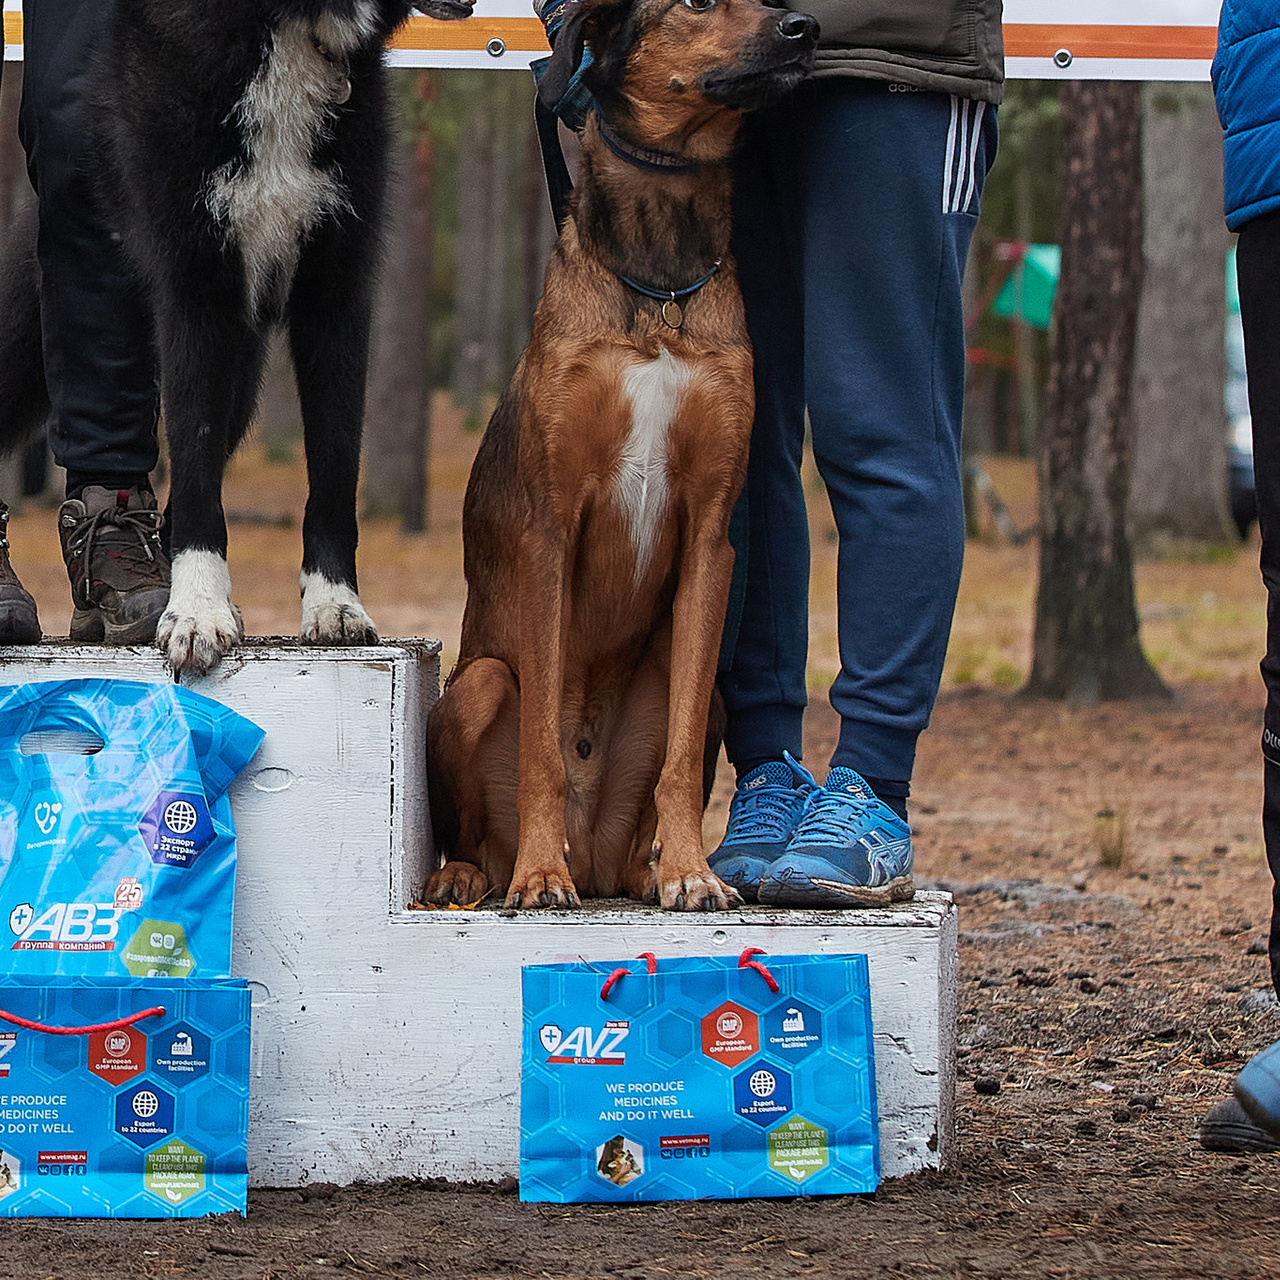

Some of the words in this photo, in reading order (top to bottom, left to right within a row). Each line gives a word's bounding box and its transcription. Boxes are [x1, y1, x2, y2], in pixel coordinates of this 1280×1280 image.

[161, 836, 195, 847] Экспорт
[160, 843, 171, 852] 22
[166, 852, 187, 861] мира
[117, 883, 142, 902] 25
[19, 903, 122, 942] АВЗ
[20, 941, 55, 951] группа
[58, 941, 106, 951] компаний
[552, 1026, 630, 1059] AVZ
[715, 1039, 746, 1047] European
[770, 1036, 785, 1044] Own
[785, 1034, 819, 1043] production
[725, 1044, 753, 1052] standard
[781, 1041, 808, 1049] facilities
[172, 1059, 207, 1067] production
[573, 1057, 597, 1065] group
[605, 1083, 626, 1094] WE
[628, 1080, 685, 1093] PRODUCE
[11, 1095, 68, 1106] PRODUCE
[613, 1095, 679, 1108] MEDICINES
[753, 1099, 775, 1108] Export
[749, 1106, 758, 1114] 22
[757, 1105, 787, 1113] countries
[598, 1111, 625, 1121] AND
[627, 1110, 646, 1121] DO
[648, 1110, 658, 1120] IT
[660, 1109, 695, 1120] WELL
[8, 1123, 26, 1134] DO
[28, 1123, 39, 1133] IT
[41, 1123, 75, 1133] WELL
[134, 1120, 156, 1128] Export
[777, 1131, 792, 1140] KEEP
[792, 1131, 803, 1139] THE
[803, 1130, 825, 1139] PLANET
[662, 1136, 709, 1145] www.vetmag.ru
[167, 1145, 185, 1154] WANT
[39, 1153, 87, 1161] www.vetmag.ru
[148, 1154, 156, 1162] TO
[156, 1154, 170, 1163] KEEP
[171, 1154, 182, 1163] THE
[182, 1155, 204, 1164] PLANET
